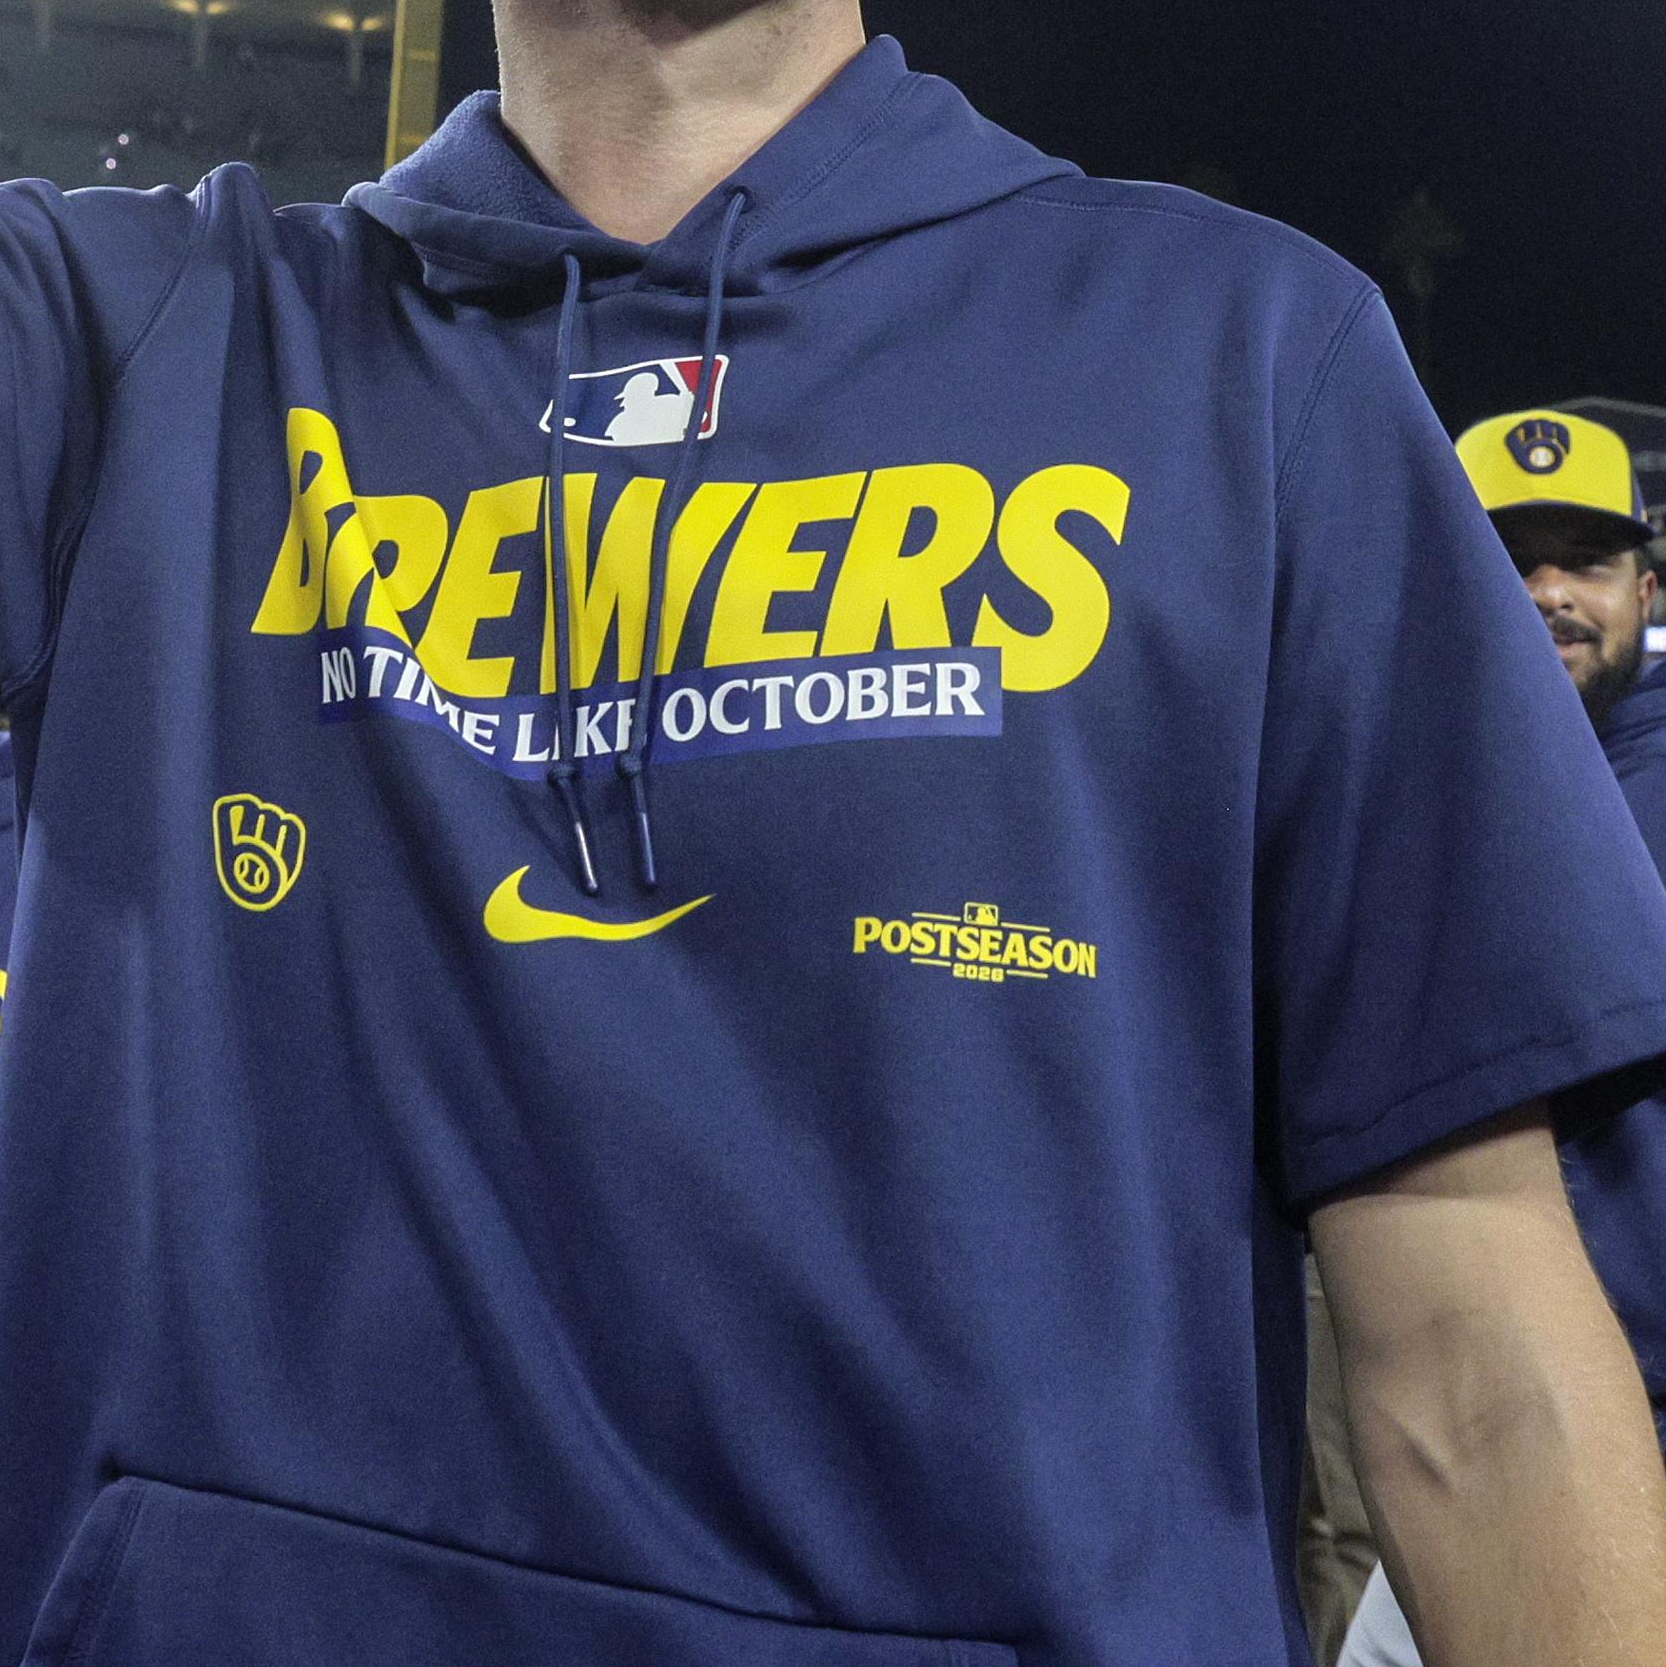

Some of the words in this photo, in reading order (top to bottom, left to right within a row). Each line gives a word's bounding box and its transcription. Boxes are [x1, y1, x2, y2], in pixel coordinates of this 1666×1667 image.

[251, 407, 1130, 697] BREWERS
[321, 646, 356, 704] NO
[363, 645, 500, 755] TIME
[512, 698, 647, 762] LKE
[662, 662, 986, 742] OCTOBER
[852, 916, 1097, 978] POSTSEASON
